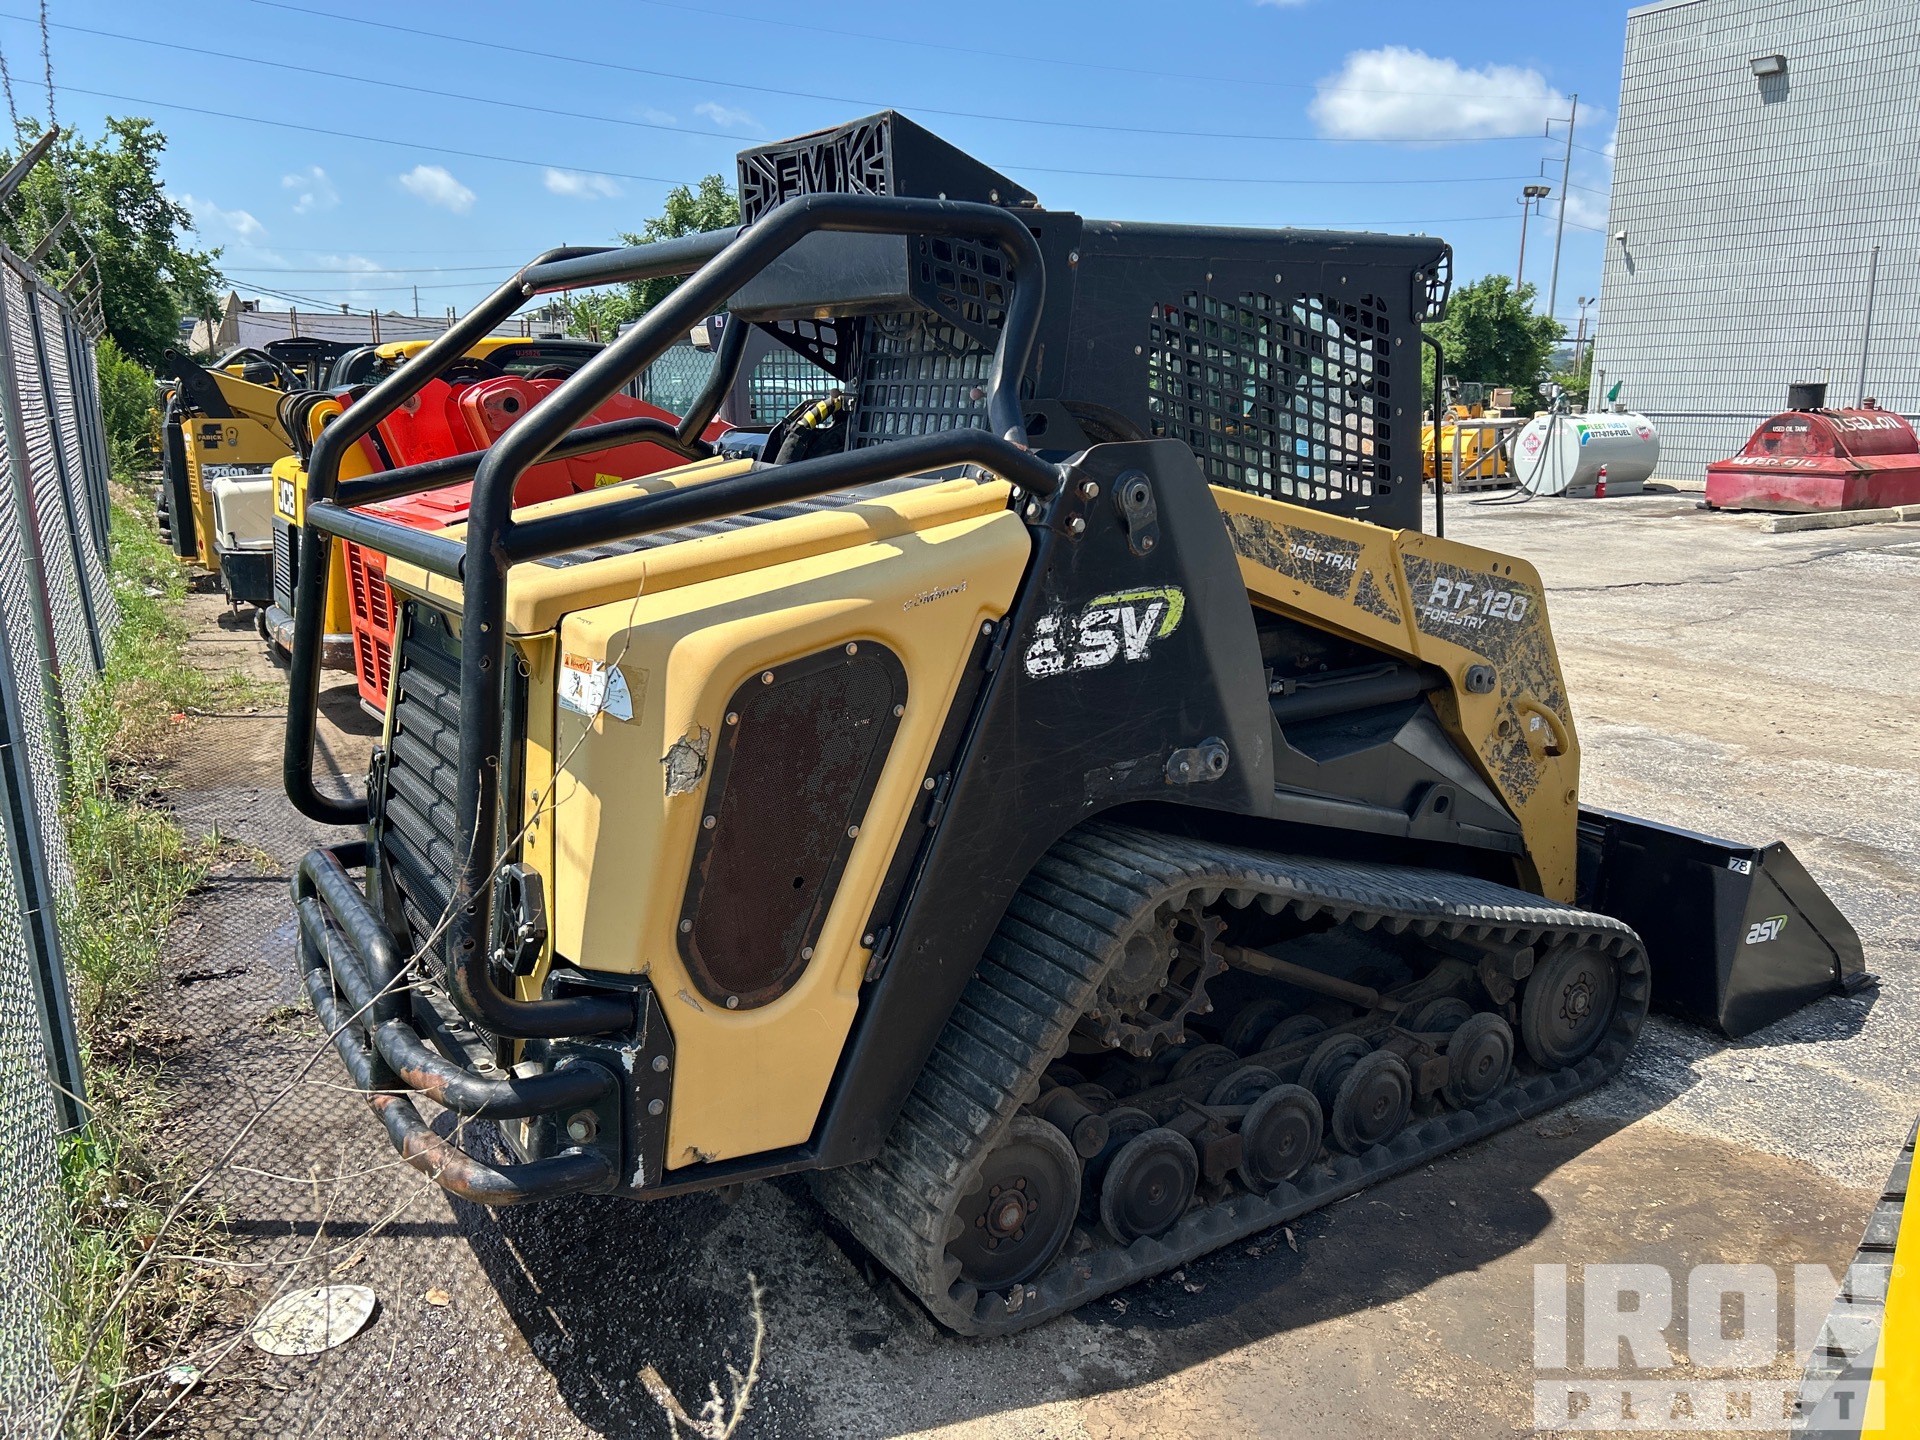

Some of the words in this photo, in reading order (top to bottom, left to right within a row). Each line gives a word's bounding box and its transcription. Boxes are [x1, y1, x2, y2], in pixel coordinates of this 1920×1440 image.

[279, 480, 295, 516] JCB
[1428, 576, 1528, 622] RT-120
[1423, 607, 1487, 630] FORESTRY
[1731, 858, 1748, 872] 78
